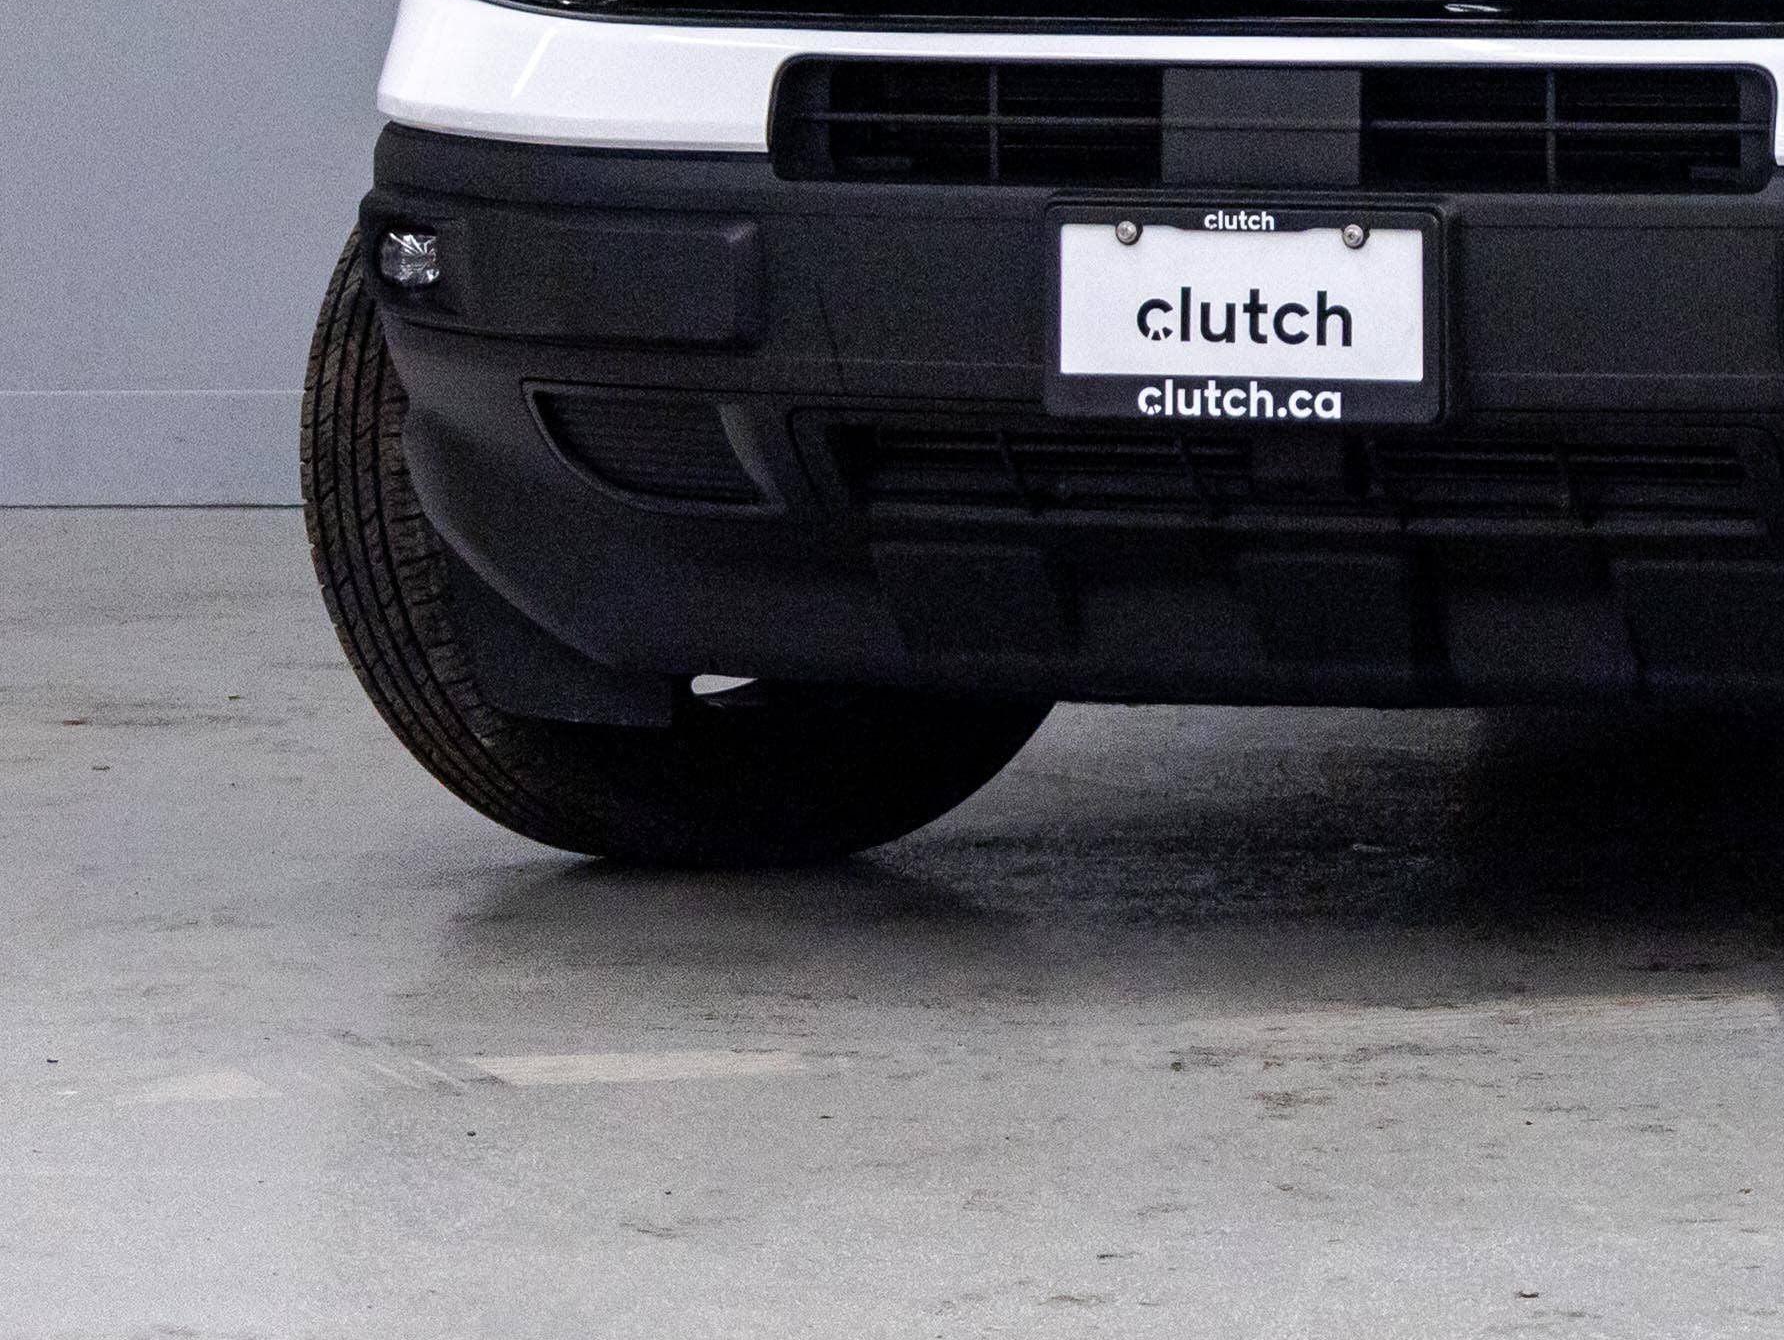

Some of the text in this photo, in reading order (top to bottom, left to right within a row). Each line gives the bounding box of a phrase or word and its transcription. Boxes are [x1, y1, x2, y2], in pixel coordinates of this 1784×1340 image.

[1203, 209, 1275, 231] clutch
[1136, 286, 1352, 347] clutch
[1137, 378, 1342, 420] clutch.ca
